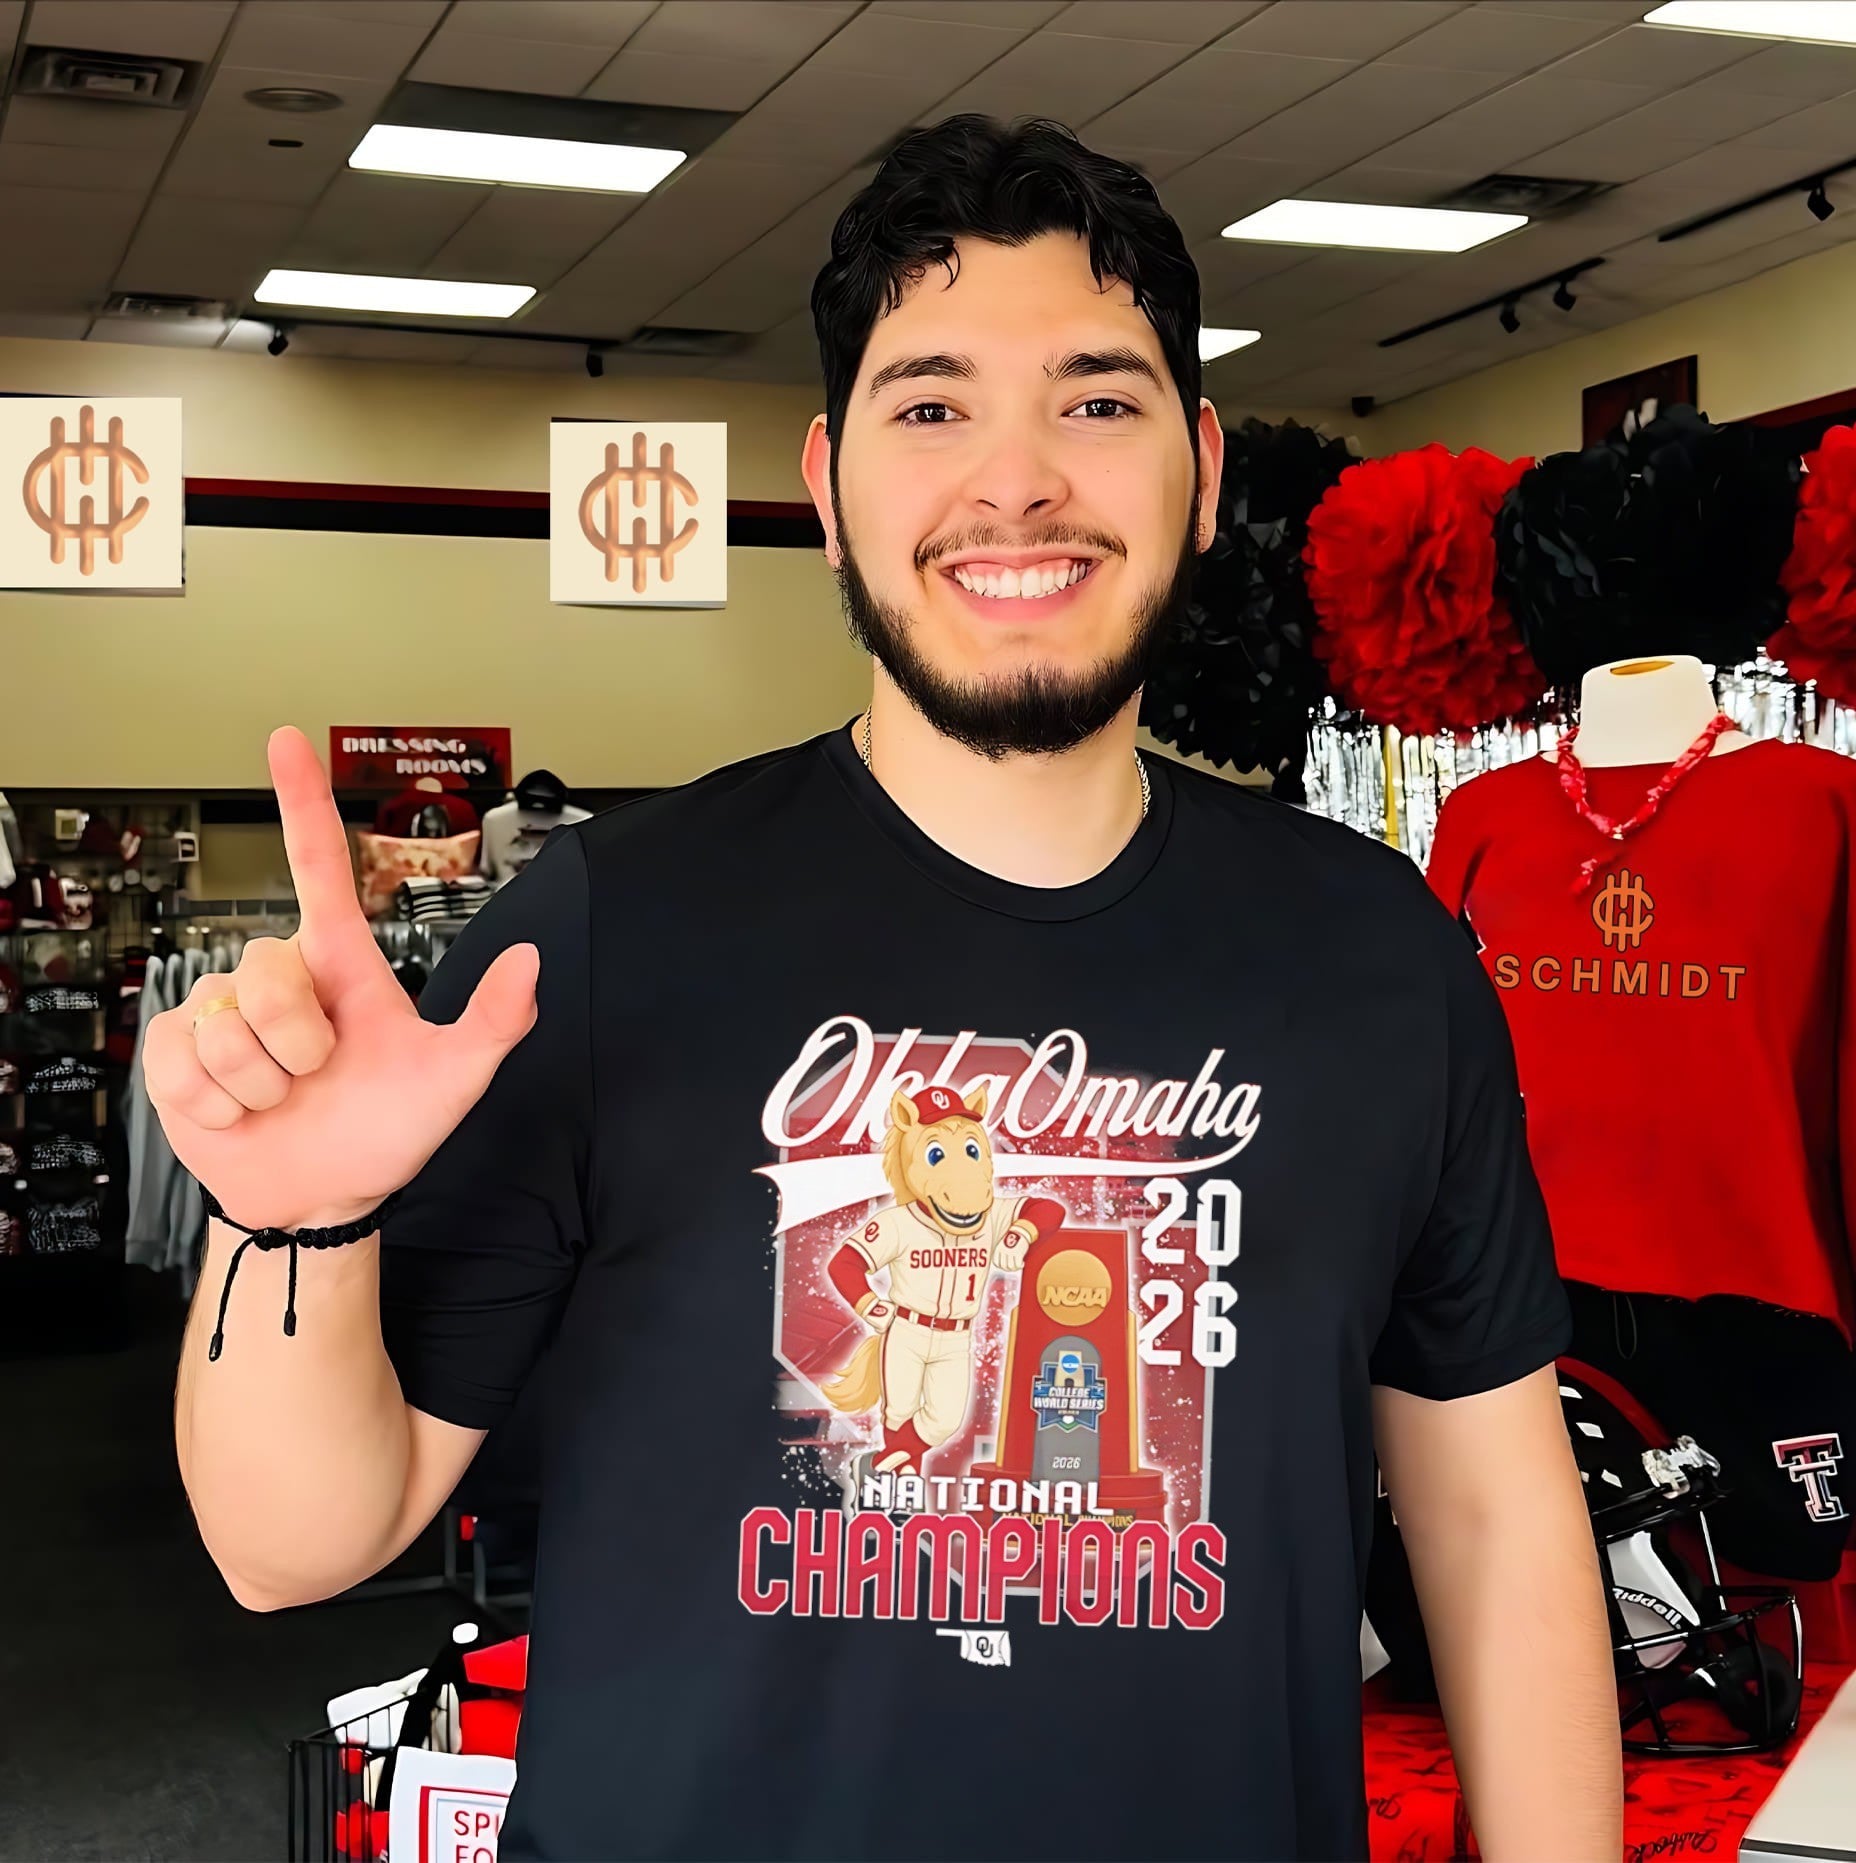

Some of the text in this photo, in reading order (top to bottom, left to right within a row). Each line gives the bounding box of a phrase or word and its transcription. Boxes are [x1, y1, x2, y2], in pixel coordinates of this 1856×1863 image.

[396, 758, 487, 775] ROOMS
[1494, 954, 1747, 1000] SCHMIDT
[1141, 1177, 1242, 1266] 20
[909, 1248, 988, 1269] SOONERS
[965, 1273, 976, 1302] 1
[1042, 1285, 1108, 1308] NCAA
[1138, 1280, 1238, 1367] 26
[1034, 1397, 1104, 1411] WORLD SERIES
[1048, 1387, 1091, 1398] COLLEGE
[1052, 1456, 1082, 1469] 2026
[863, 1474, 1114, 1515] NATIONAL
[738, 1507, 1227, 1631] CHAMPIONS
